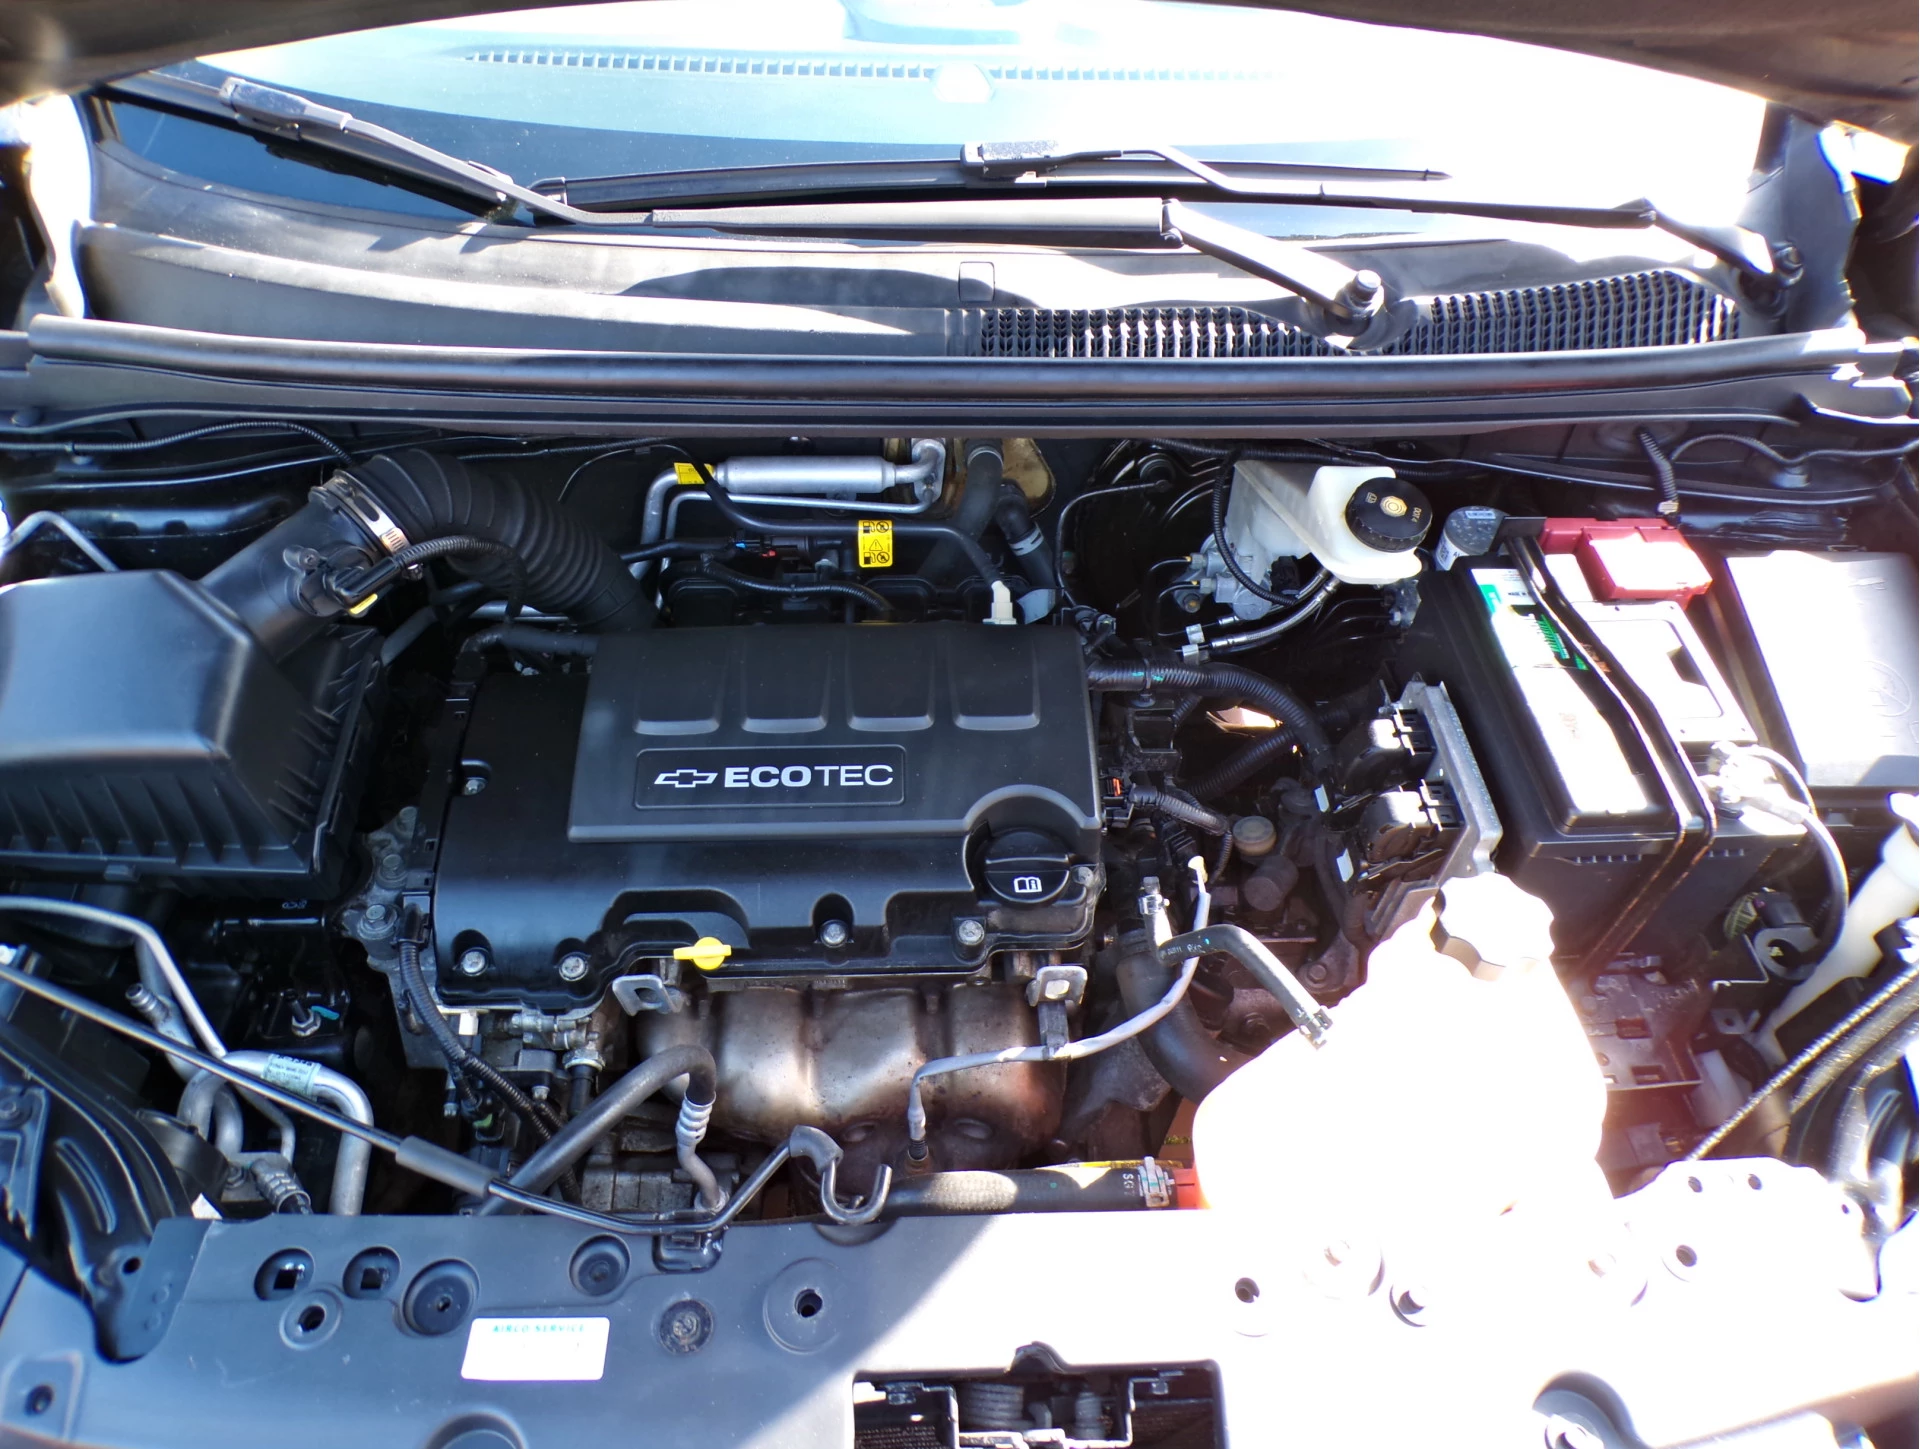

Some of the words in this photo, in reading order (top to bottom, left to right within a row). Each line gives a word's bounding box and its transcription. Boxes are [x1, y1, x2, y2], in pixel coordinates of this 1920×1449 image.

[1413, 507, 1422, 519] DOT
[724, 764, 894, 788] ECOTEC
[492, 1324, 530, 1333] AIRCO
[534, 1324, 585, 1333] SERVICE
